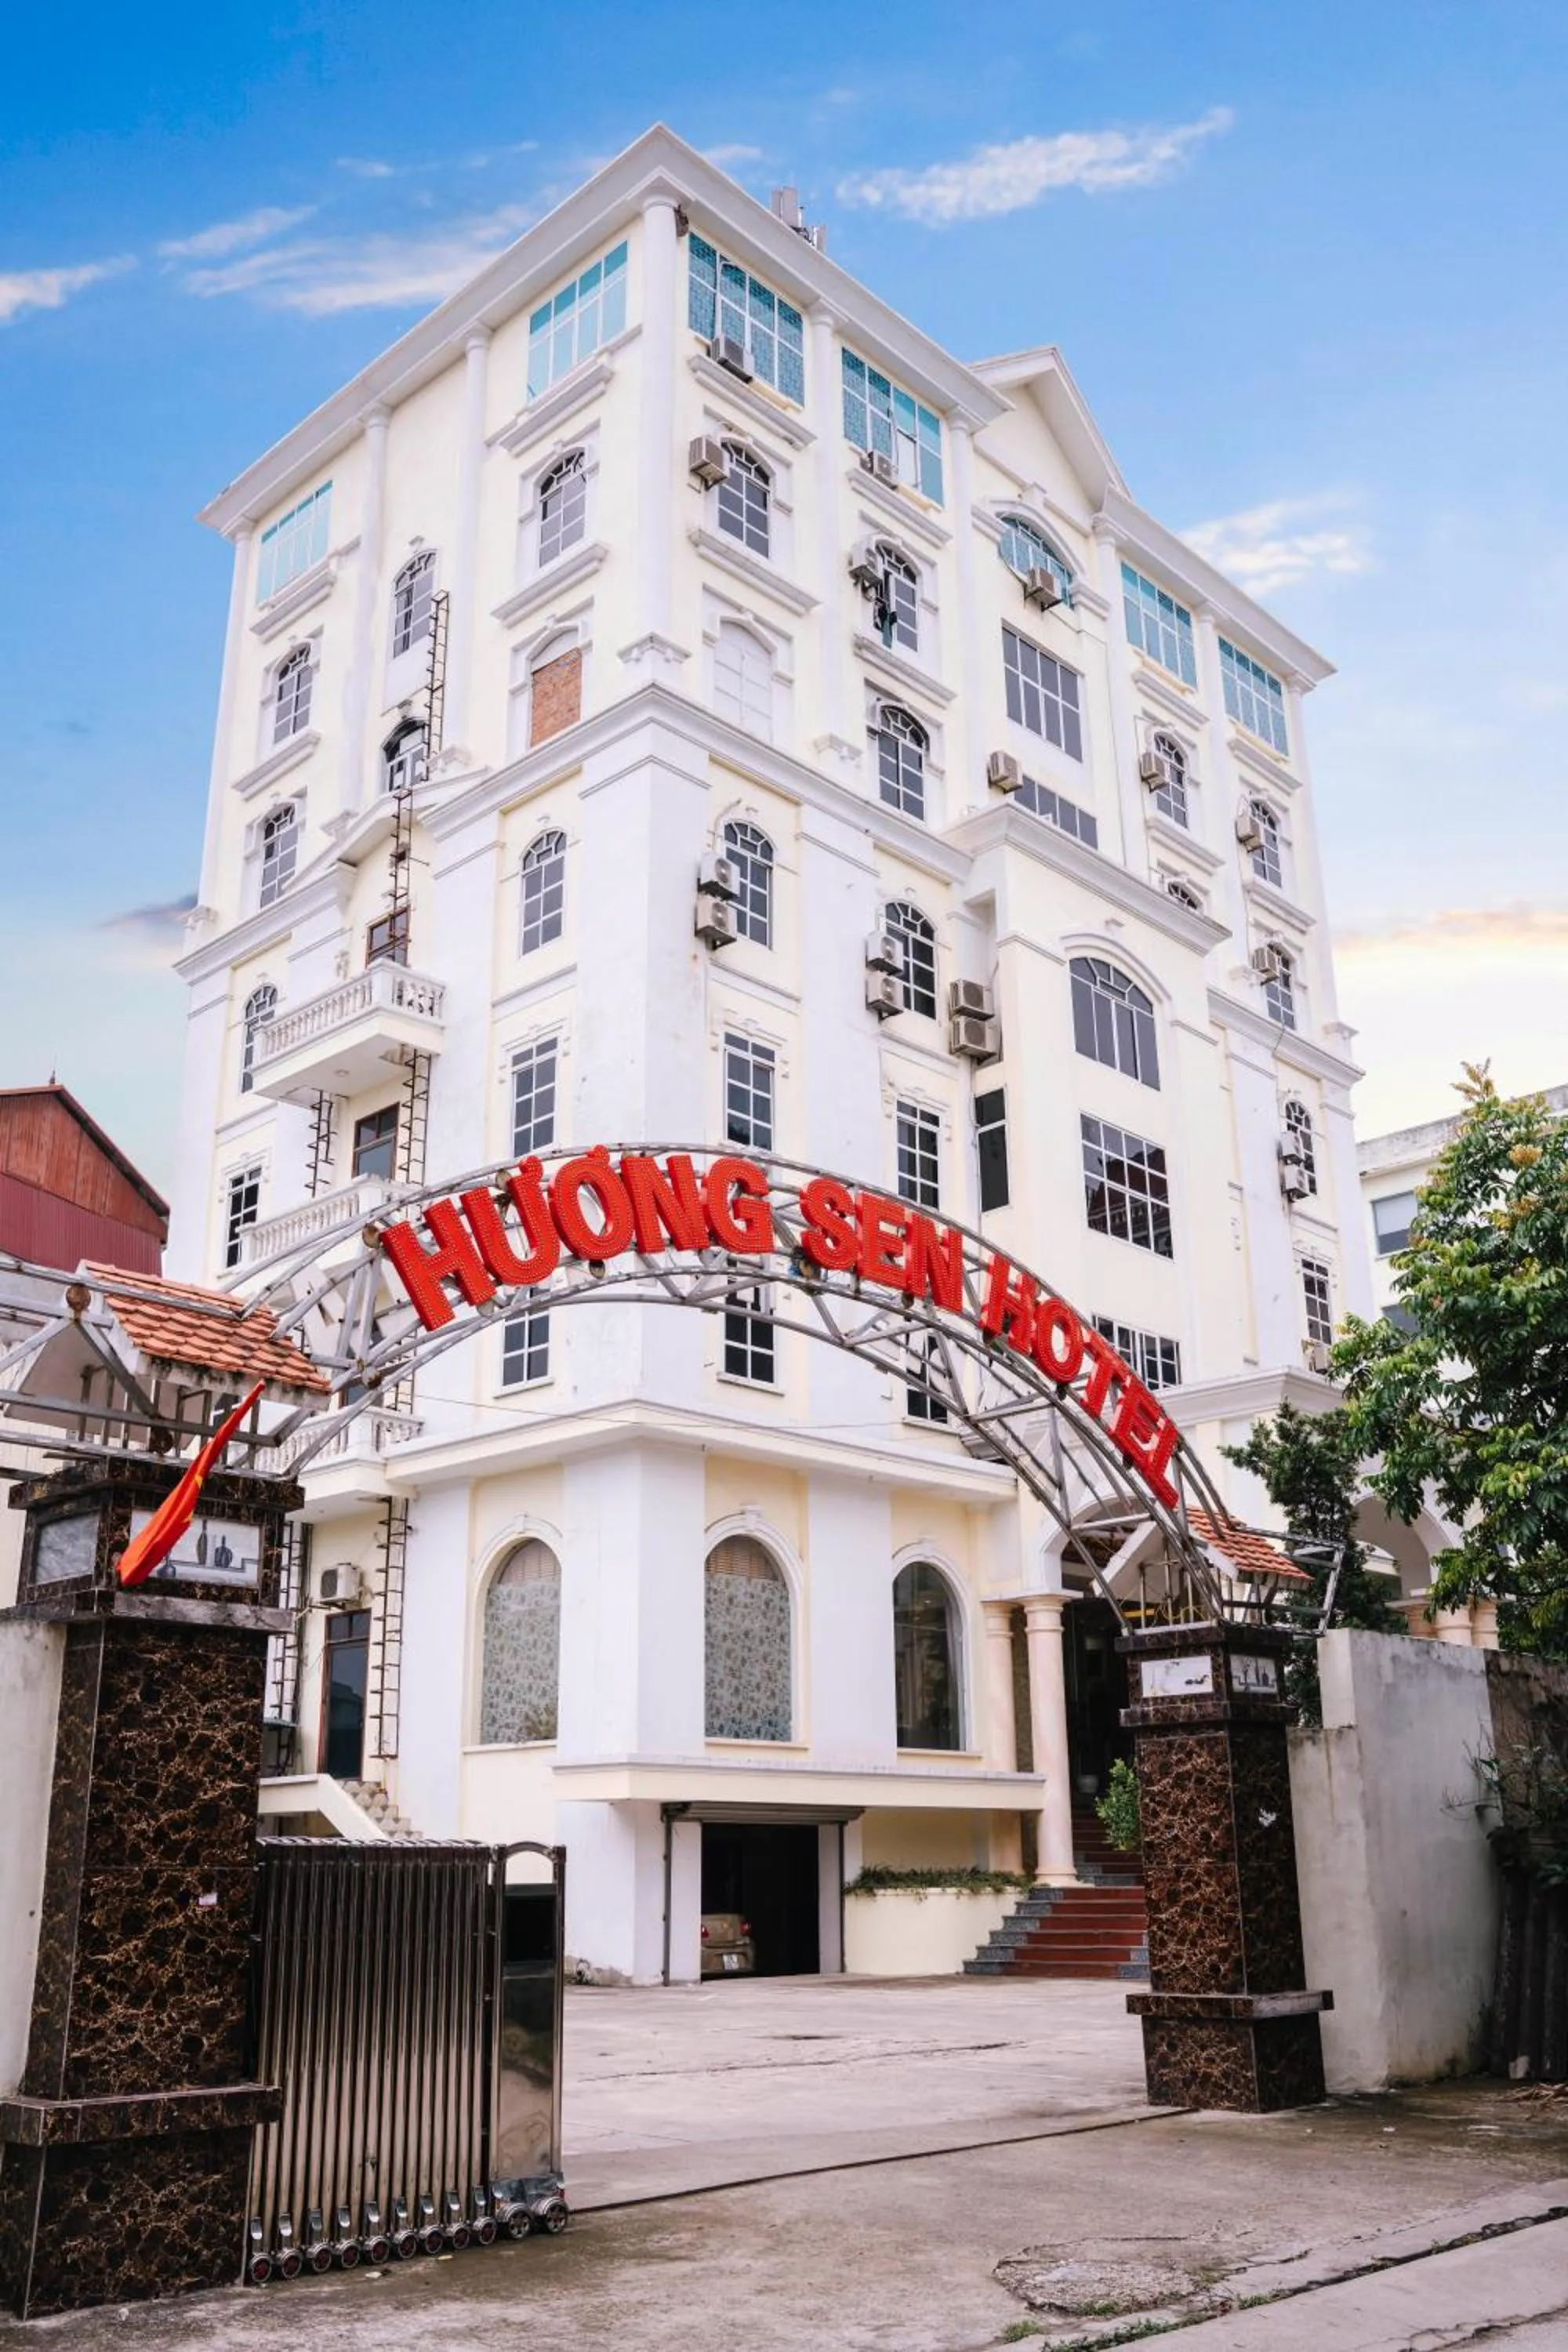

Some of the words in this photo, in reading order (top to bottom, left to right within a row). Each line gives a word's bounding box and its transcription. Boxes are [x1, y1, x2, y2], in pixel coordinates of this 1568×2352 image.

[381, 1145, 775, 1331] HƯƠNG
[800, 1178, 964, 1313] SEN
[980, 1254, 1179, 1509] HOTEL
